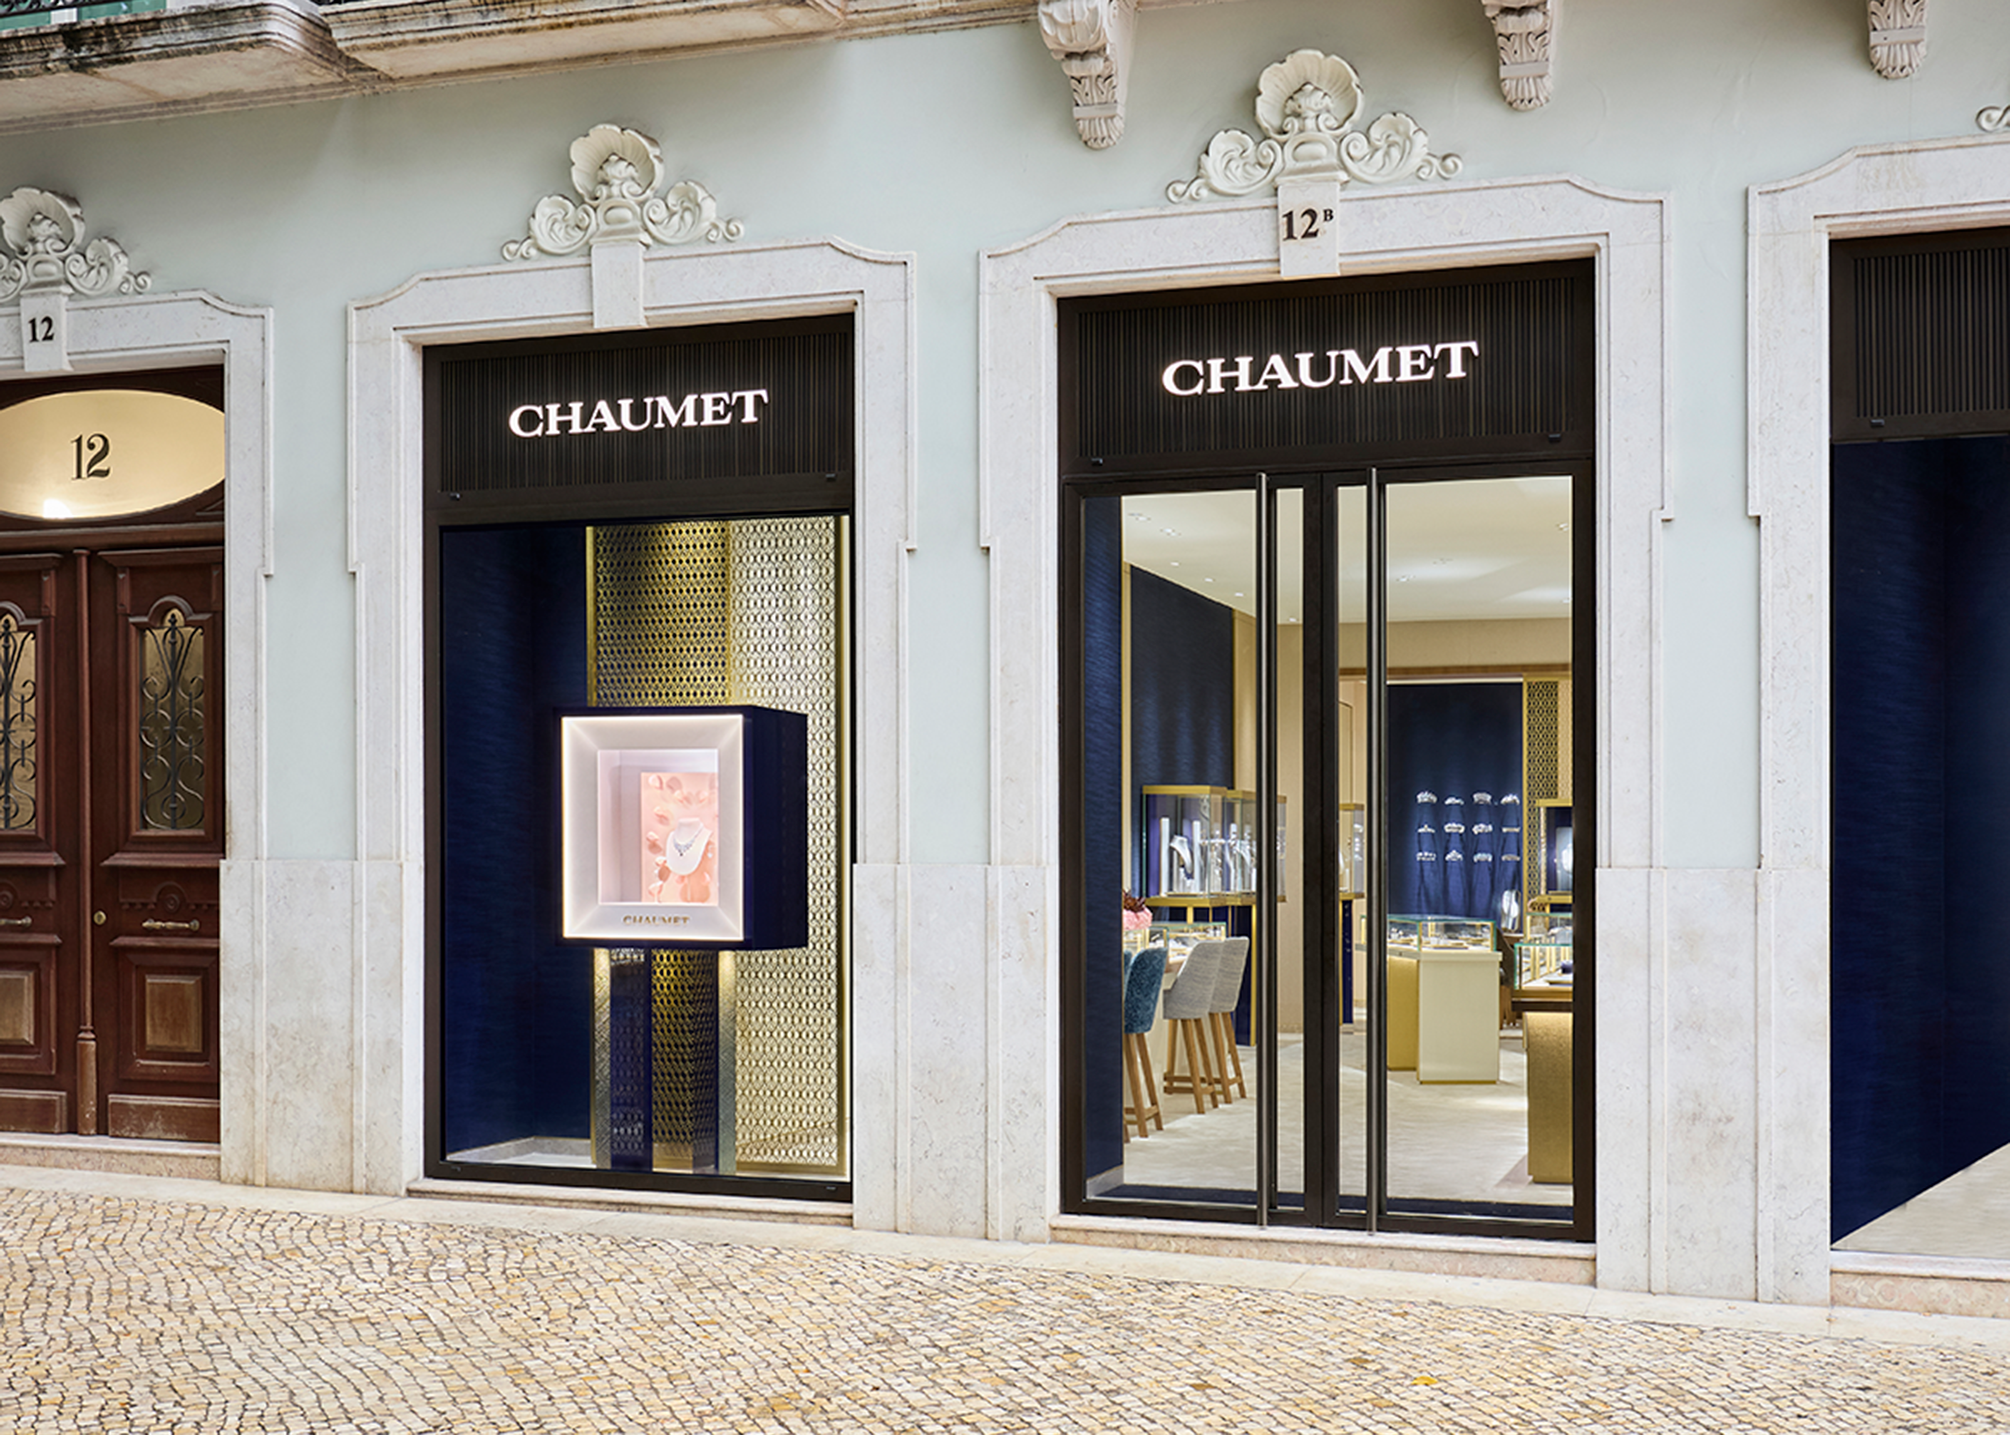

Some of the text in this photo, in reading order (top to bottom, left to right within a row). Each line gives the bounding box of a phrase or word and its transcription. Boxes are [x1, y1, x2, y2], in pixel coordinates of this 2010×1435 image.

[28, 316, 54, 343] 12
[1162, 341, 1479, 395] CHAUMET
[508, 389, 769, 438] CHAUMET
[70, 433, 110, 480] 12
[623, 914, 691, 926] CHAUMET
